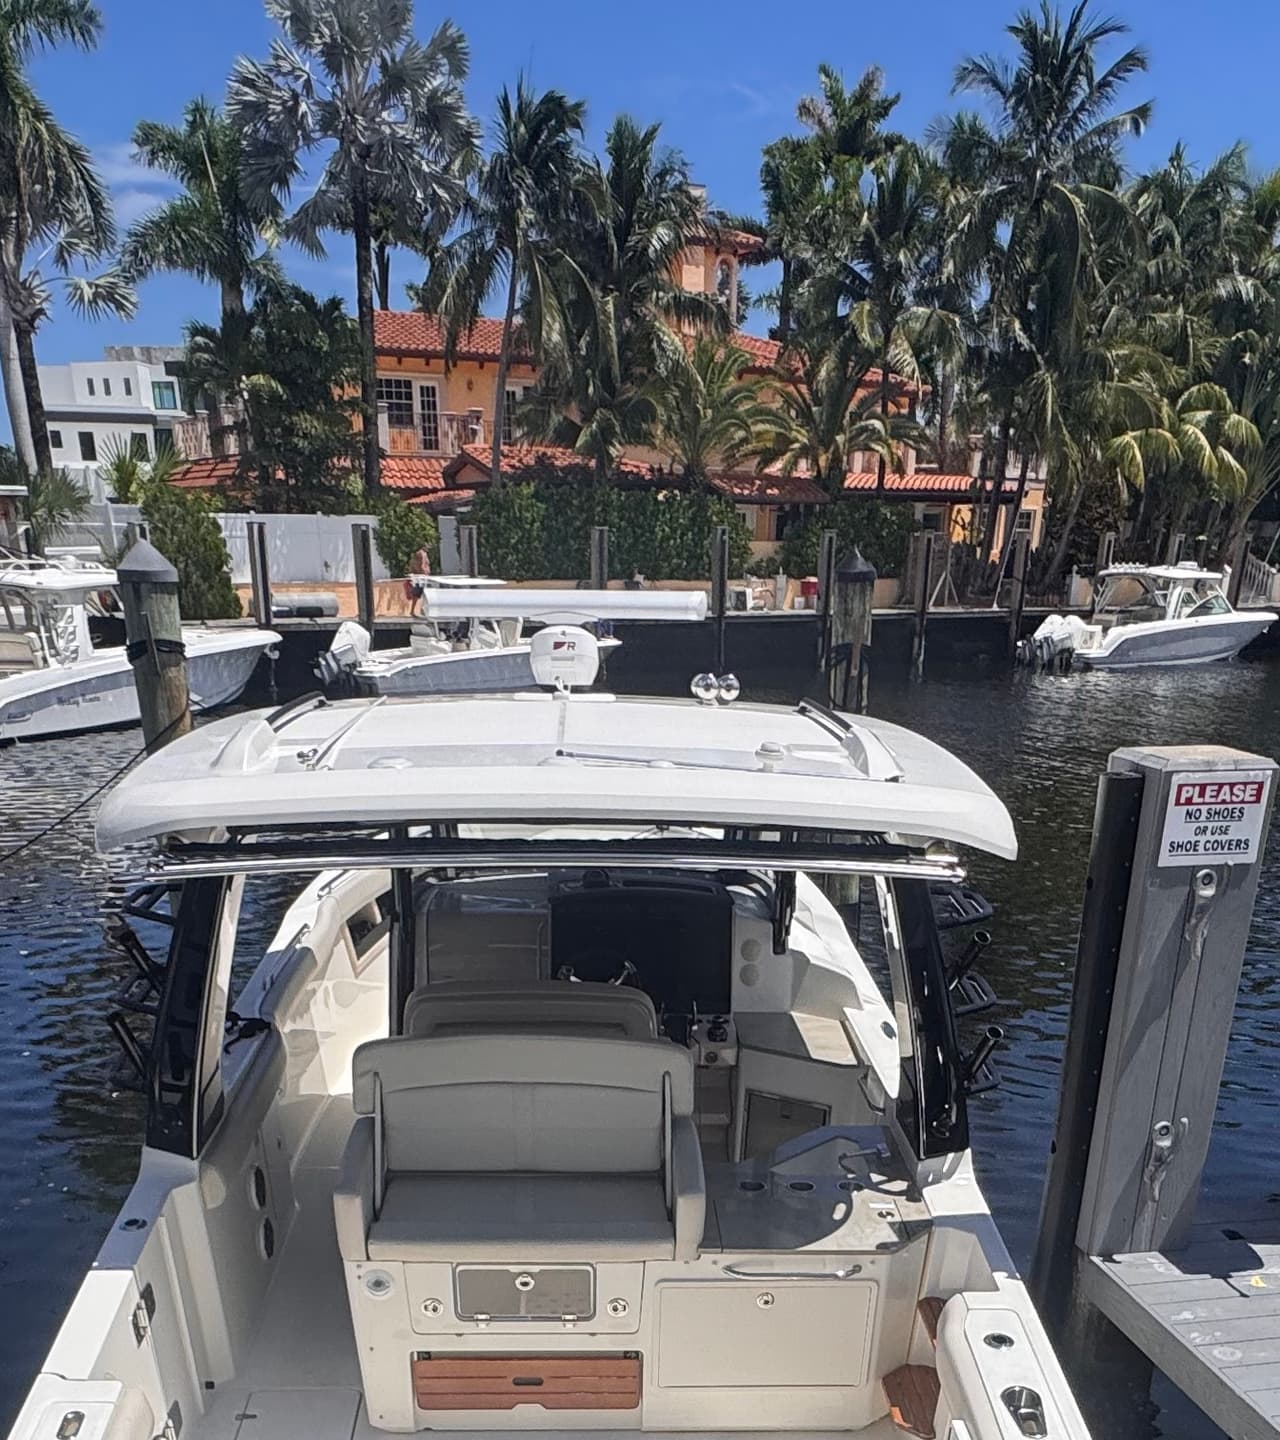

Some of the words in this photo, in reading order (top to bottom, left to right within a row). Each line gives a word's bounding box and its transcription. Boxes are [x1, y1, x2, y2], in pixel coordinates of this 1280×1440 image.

[1179, 783, 1259, 804] PLEASE
[1184, 808, 1203, 821] NO
[1205, 806, 1245, 820] SHOES
[1193, 825, 1209, 837] OR
[1210, 824, 1232, 836] USE
[1168, 840, 1201, 854] SHOE
[1203, 838, 1250, 852] COVERS
